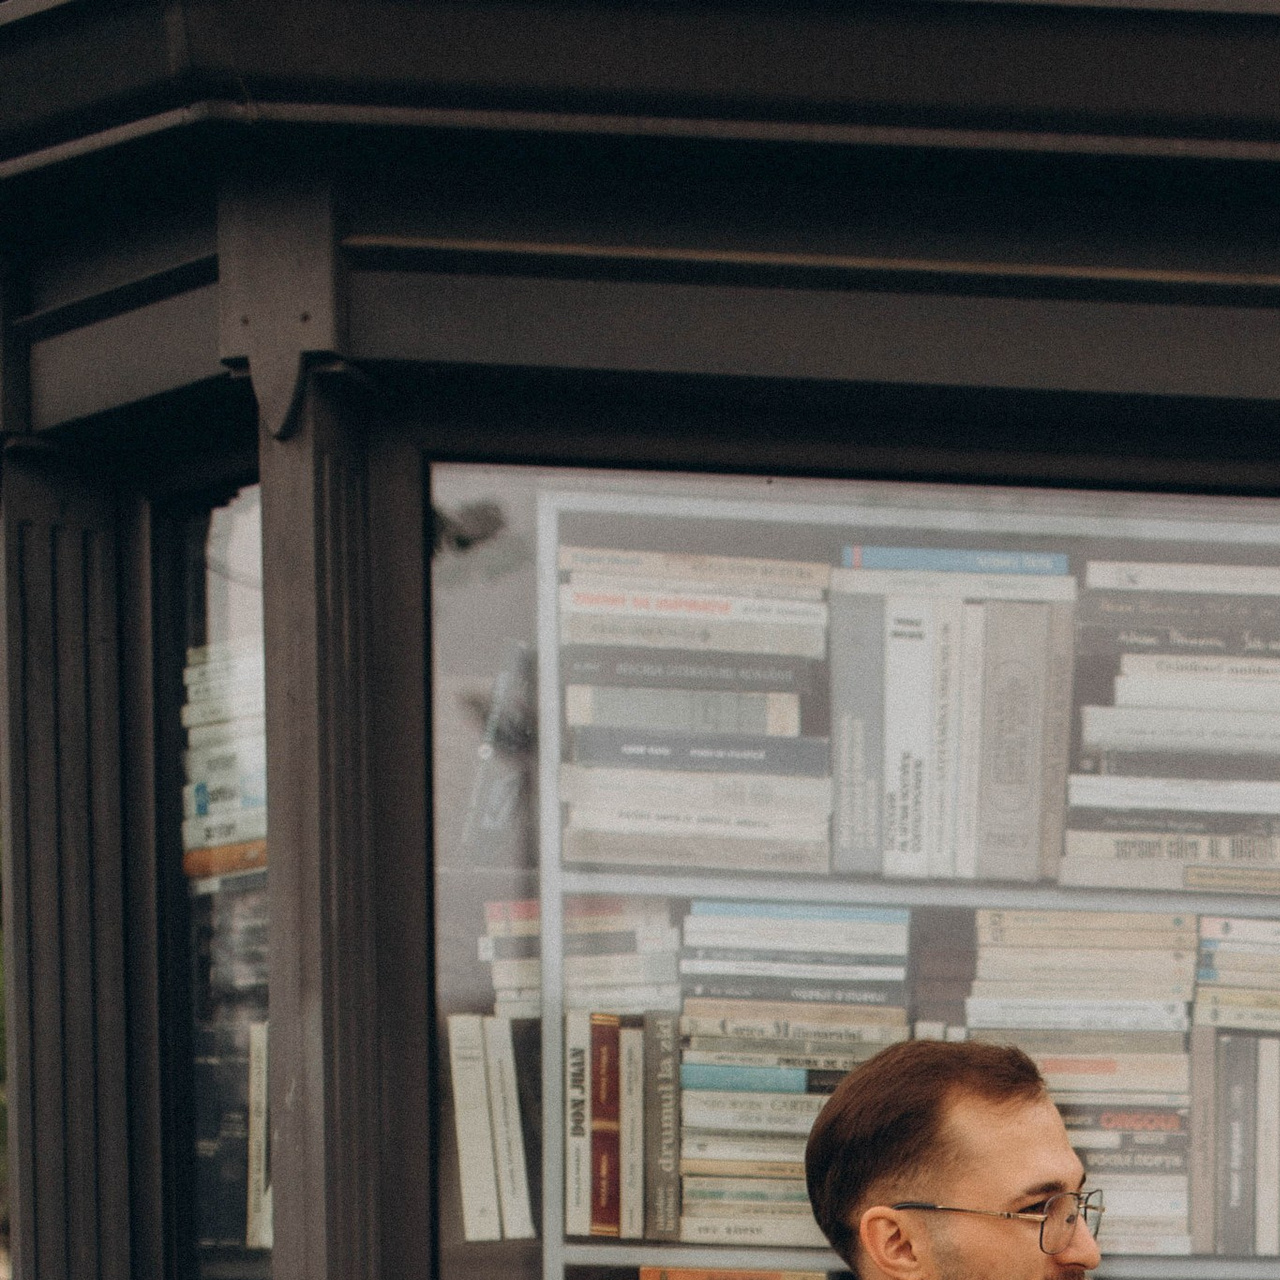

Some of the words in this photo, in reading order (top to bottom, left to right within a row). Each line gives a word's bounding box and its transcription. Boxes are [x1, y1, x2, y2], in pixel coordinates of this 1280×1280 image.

[656, 1018, 676, 1054] zid
[569, 1047, 586, 1094] JUAN
[657, 1059, 675, 1080] la
[570, 1098, 586, 1138] DON
[658, 1084, 676, 1173] drumul
